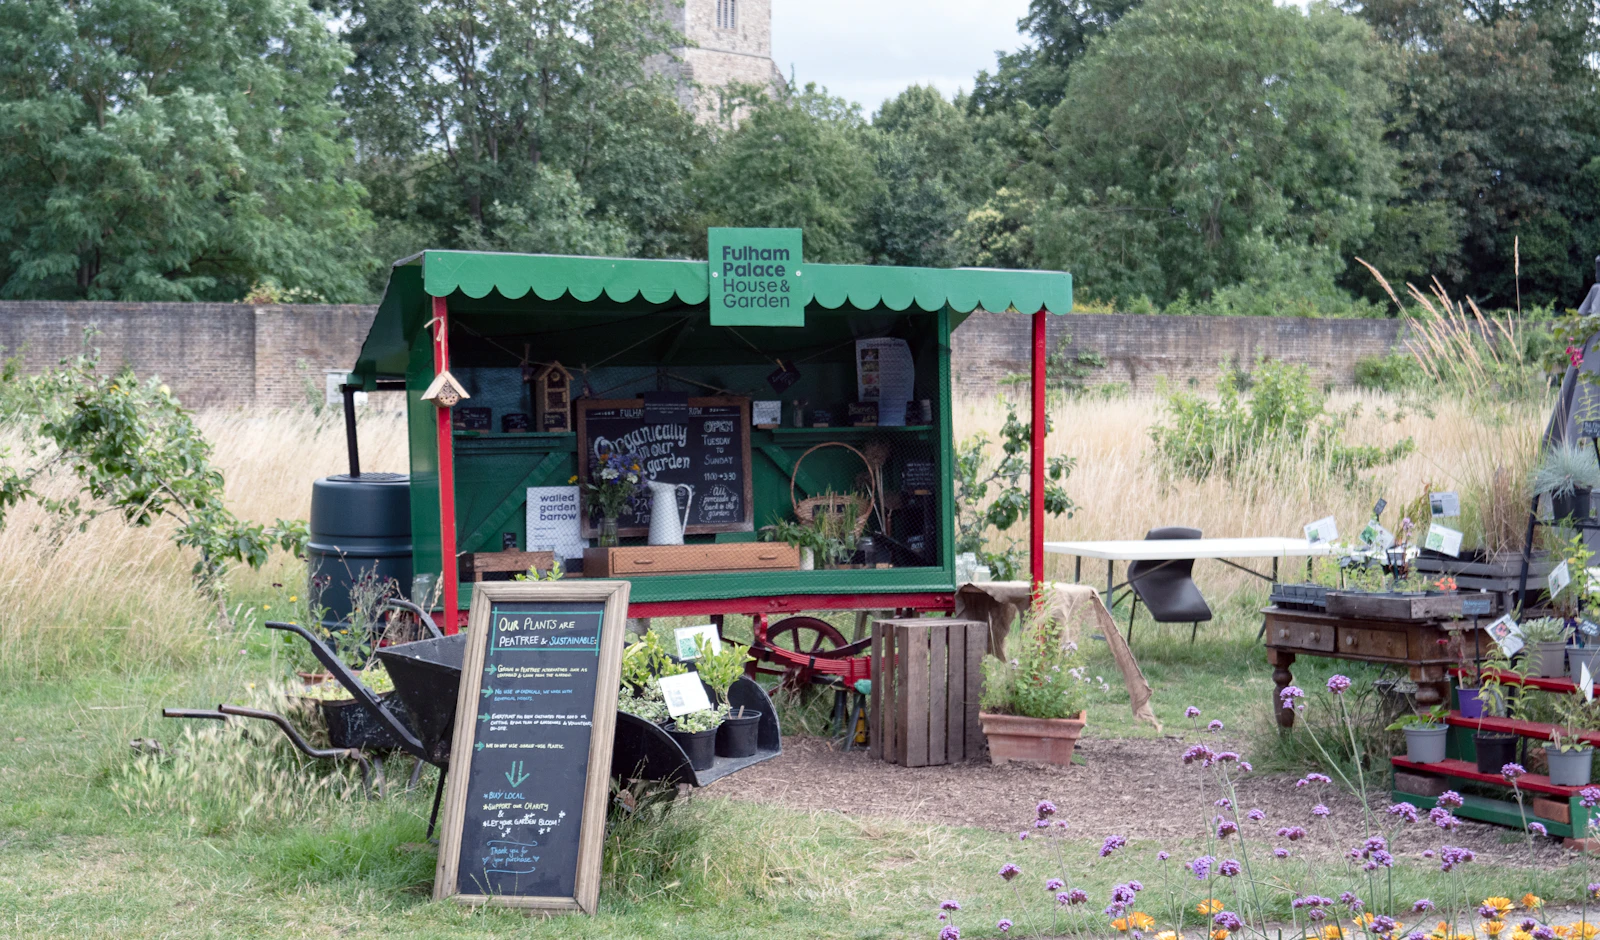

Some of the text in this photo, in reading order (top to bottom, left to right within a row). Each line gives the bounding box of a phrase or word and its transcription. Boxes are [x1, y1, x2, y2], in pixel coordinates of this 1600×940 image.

[722, 246, 789, 260] Fulham
[723, 262, 786, 277] Palace
[723, 294, 790, 308] Garden
[703, 420, 733, 433] OPEN
[594, 423, 687, 459] Organically
[637, 442, 674, 459] in our
[647, 453, 691, 480] garden
[540, 494, 574, 502] walled
[540, 503, 576, 513] garden
[499, 635, 539, 647] PEATFREE
[541, 637, 548, 645] &
[504, 792, 525, 800] LOCAL
